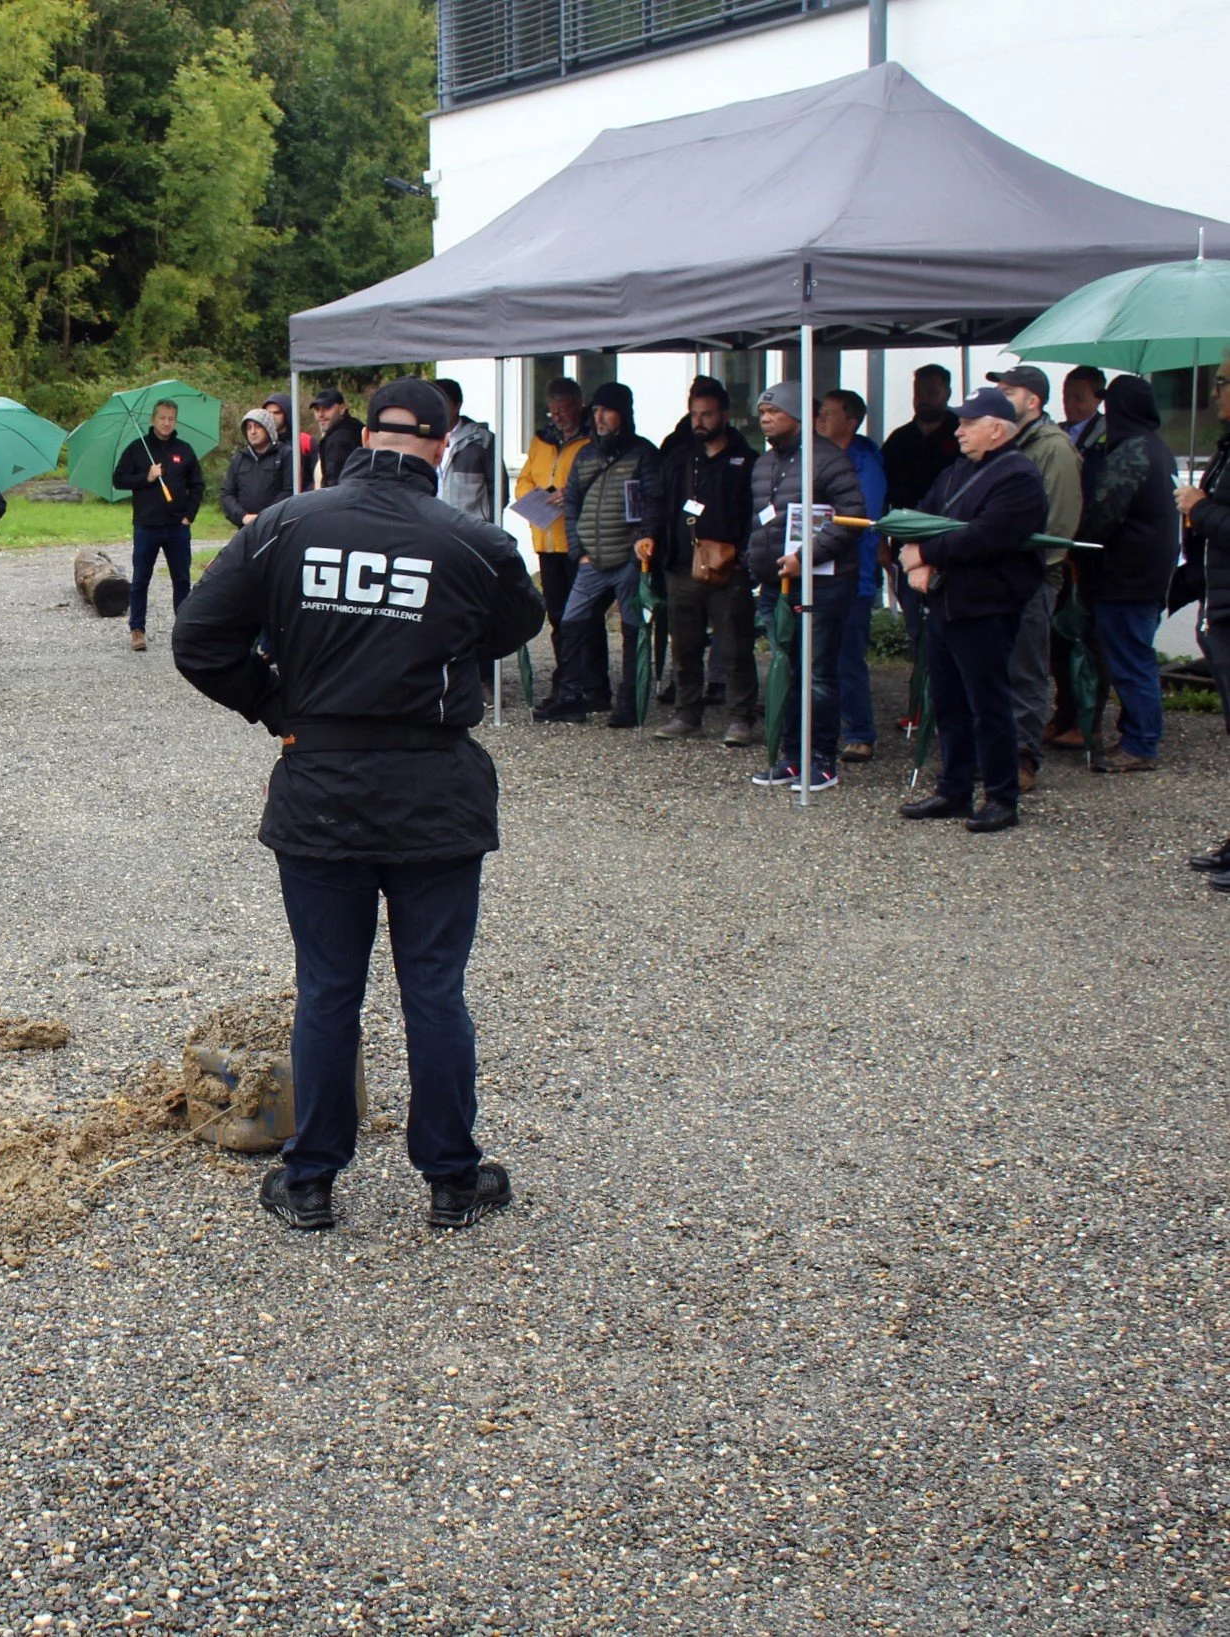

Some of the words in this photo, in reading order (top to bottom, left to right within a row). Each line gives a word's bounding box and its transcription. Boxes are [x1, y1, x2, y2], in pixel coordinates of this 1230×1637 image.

[302, 546, 433, 609] GCS
[301, 601, 331, 611] SAFETY
[331, 603, 373, 616] THROUGH
[373, 608, 424, 622] EXCELLENCE
